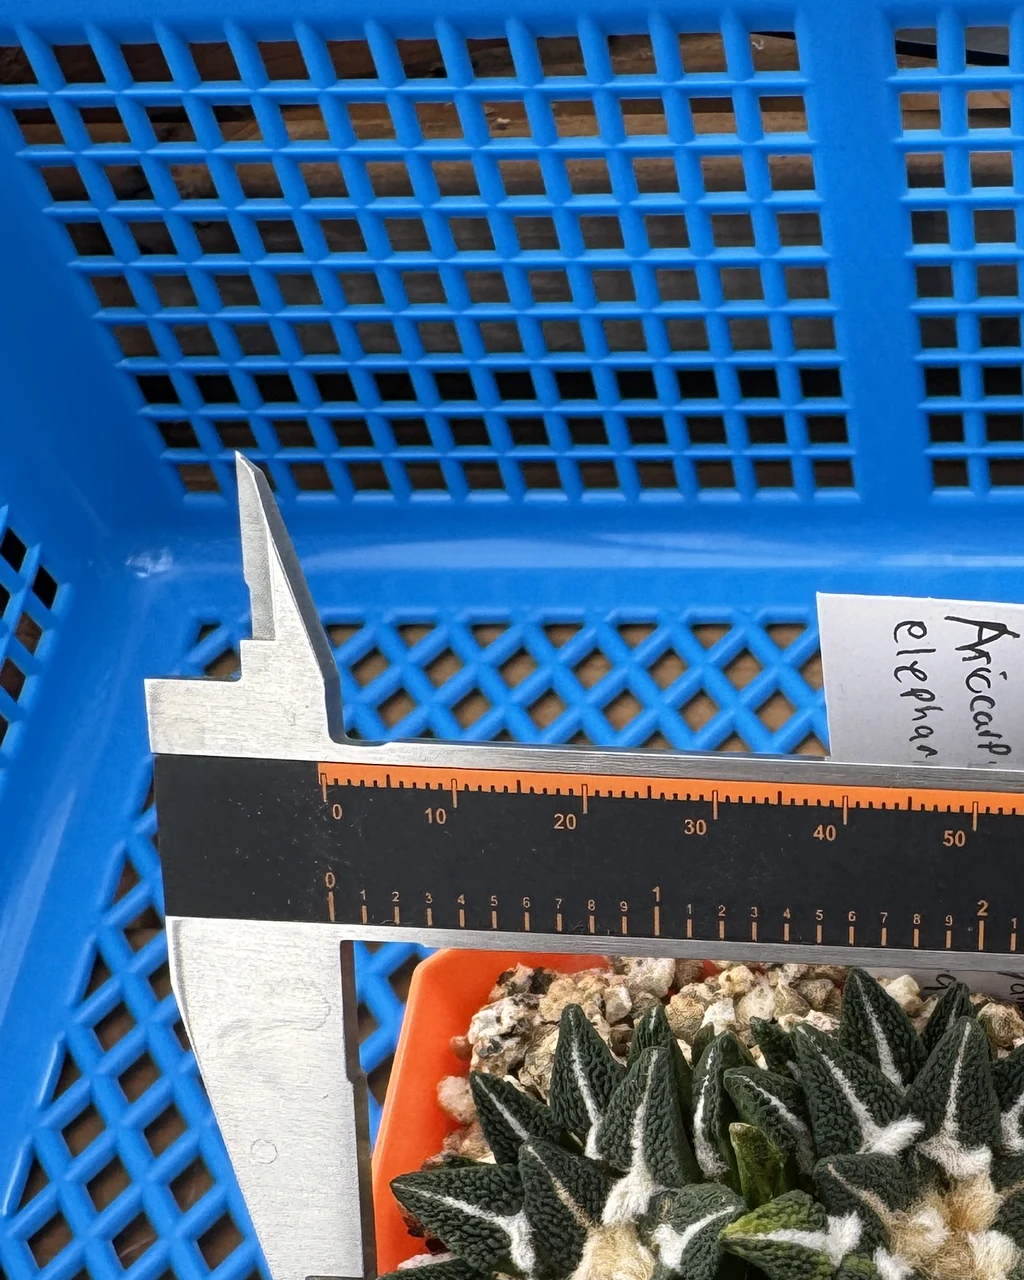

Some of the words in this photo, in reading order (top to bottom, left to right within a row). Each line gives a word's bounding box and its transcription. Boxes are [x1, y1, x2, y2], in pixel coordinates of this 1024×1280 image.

[332, 803, 343, 820] 0
[424, 807, 447, 825] 10
[553, 813, 577, 830] 20
[684, 819, 707, 836] 30
[813, 824, 837, 842] 40
[942, 830, 966, 847] 50
